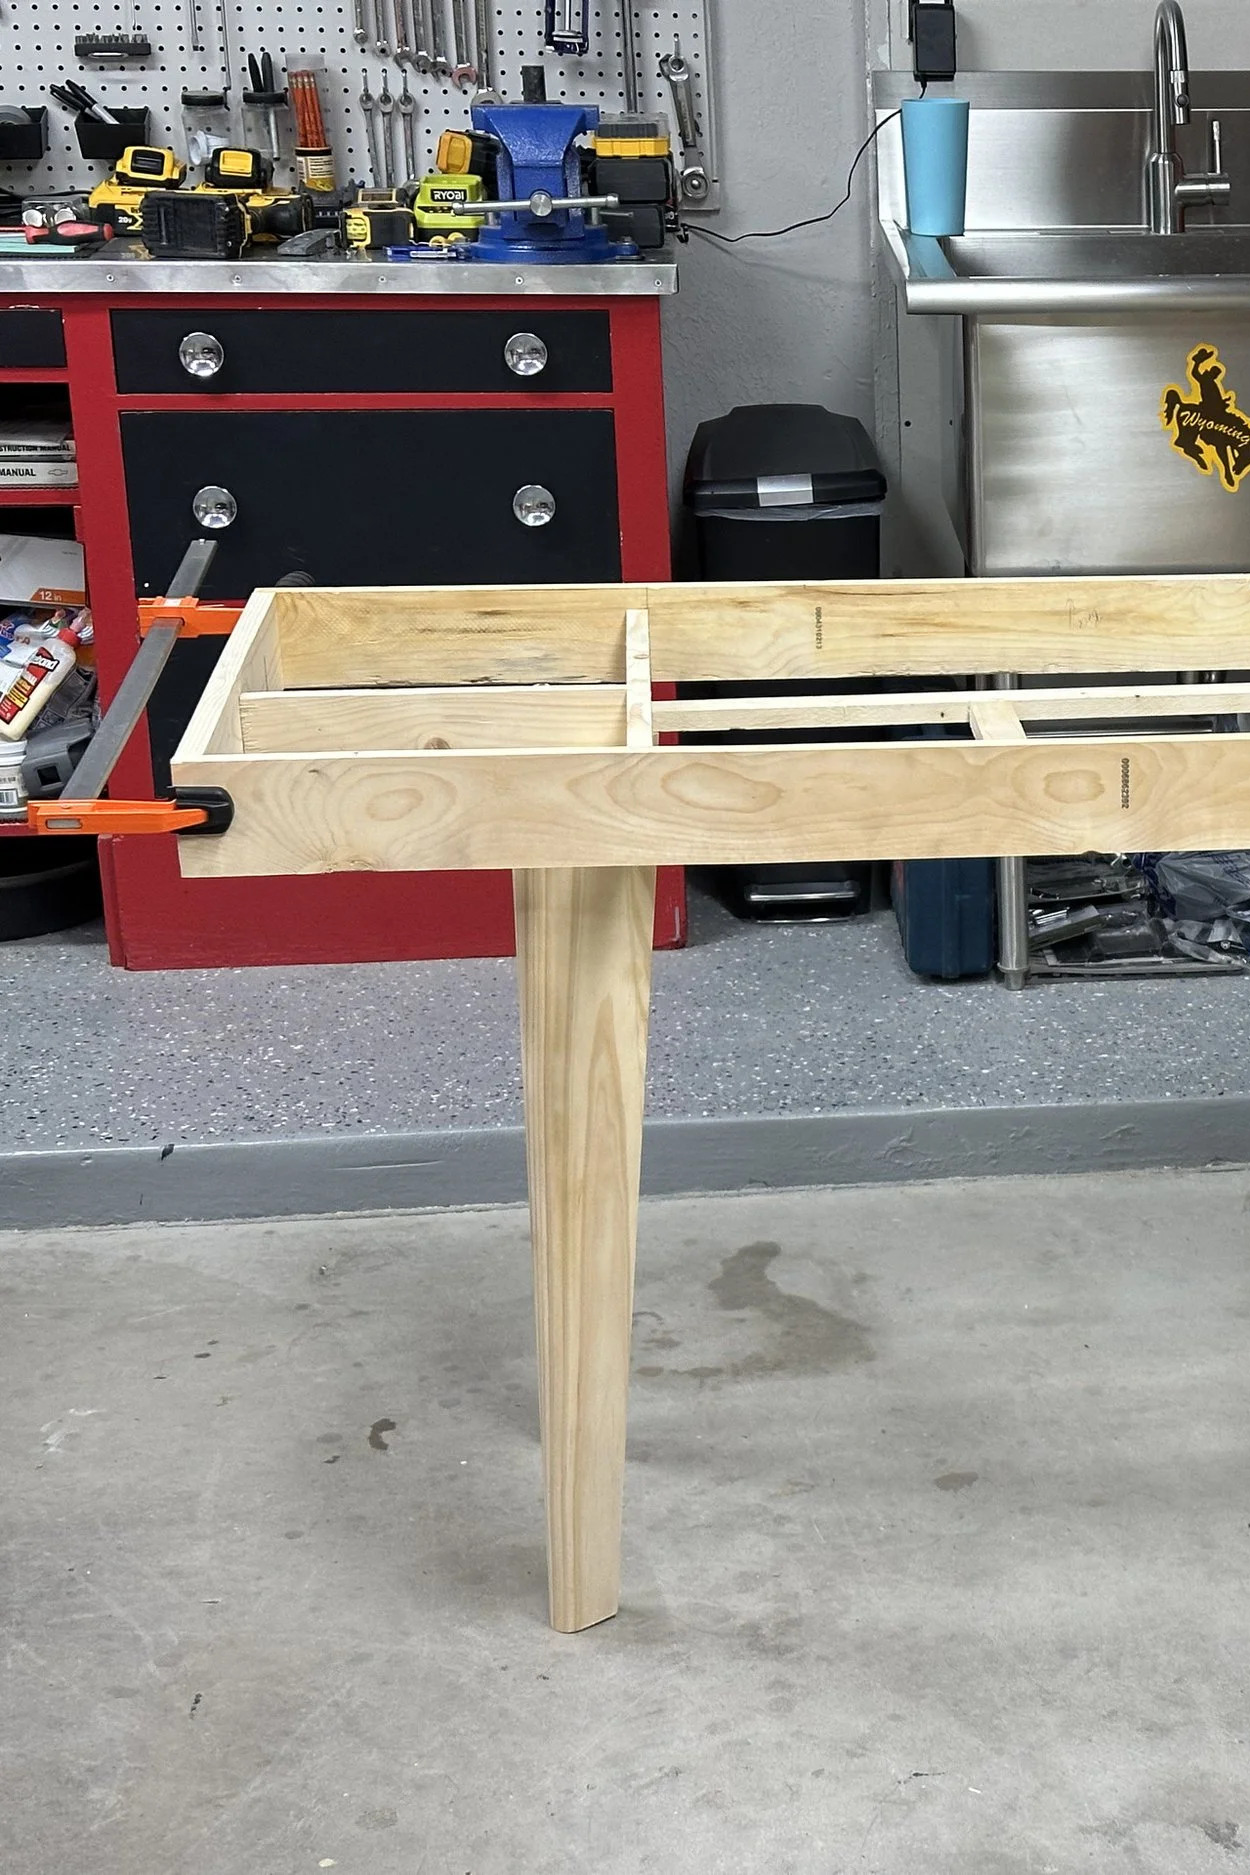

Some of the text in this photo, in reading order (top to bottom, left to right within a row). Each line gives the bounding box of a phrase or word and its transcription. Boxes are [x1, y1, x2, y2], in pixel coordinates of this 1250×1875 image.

[433, 191, 464, 200] RYOBI
[1180, 411, 1250, 447] Wyoming
[40, 591, 52, 601] 12
